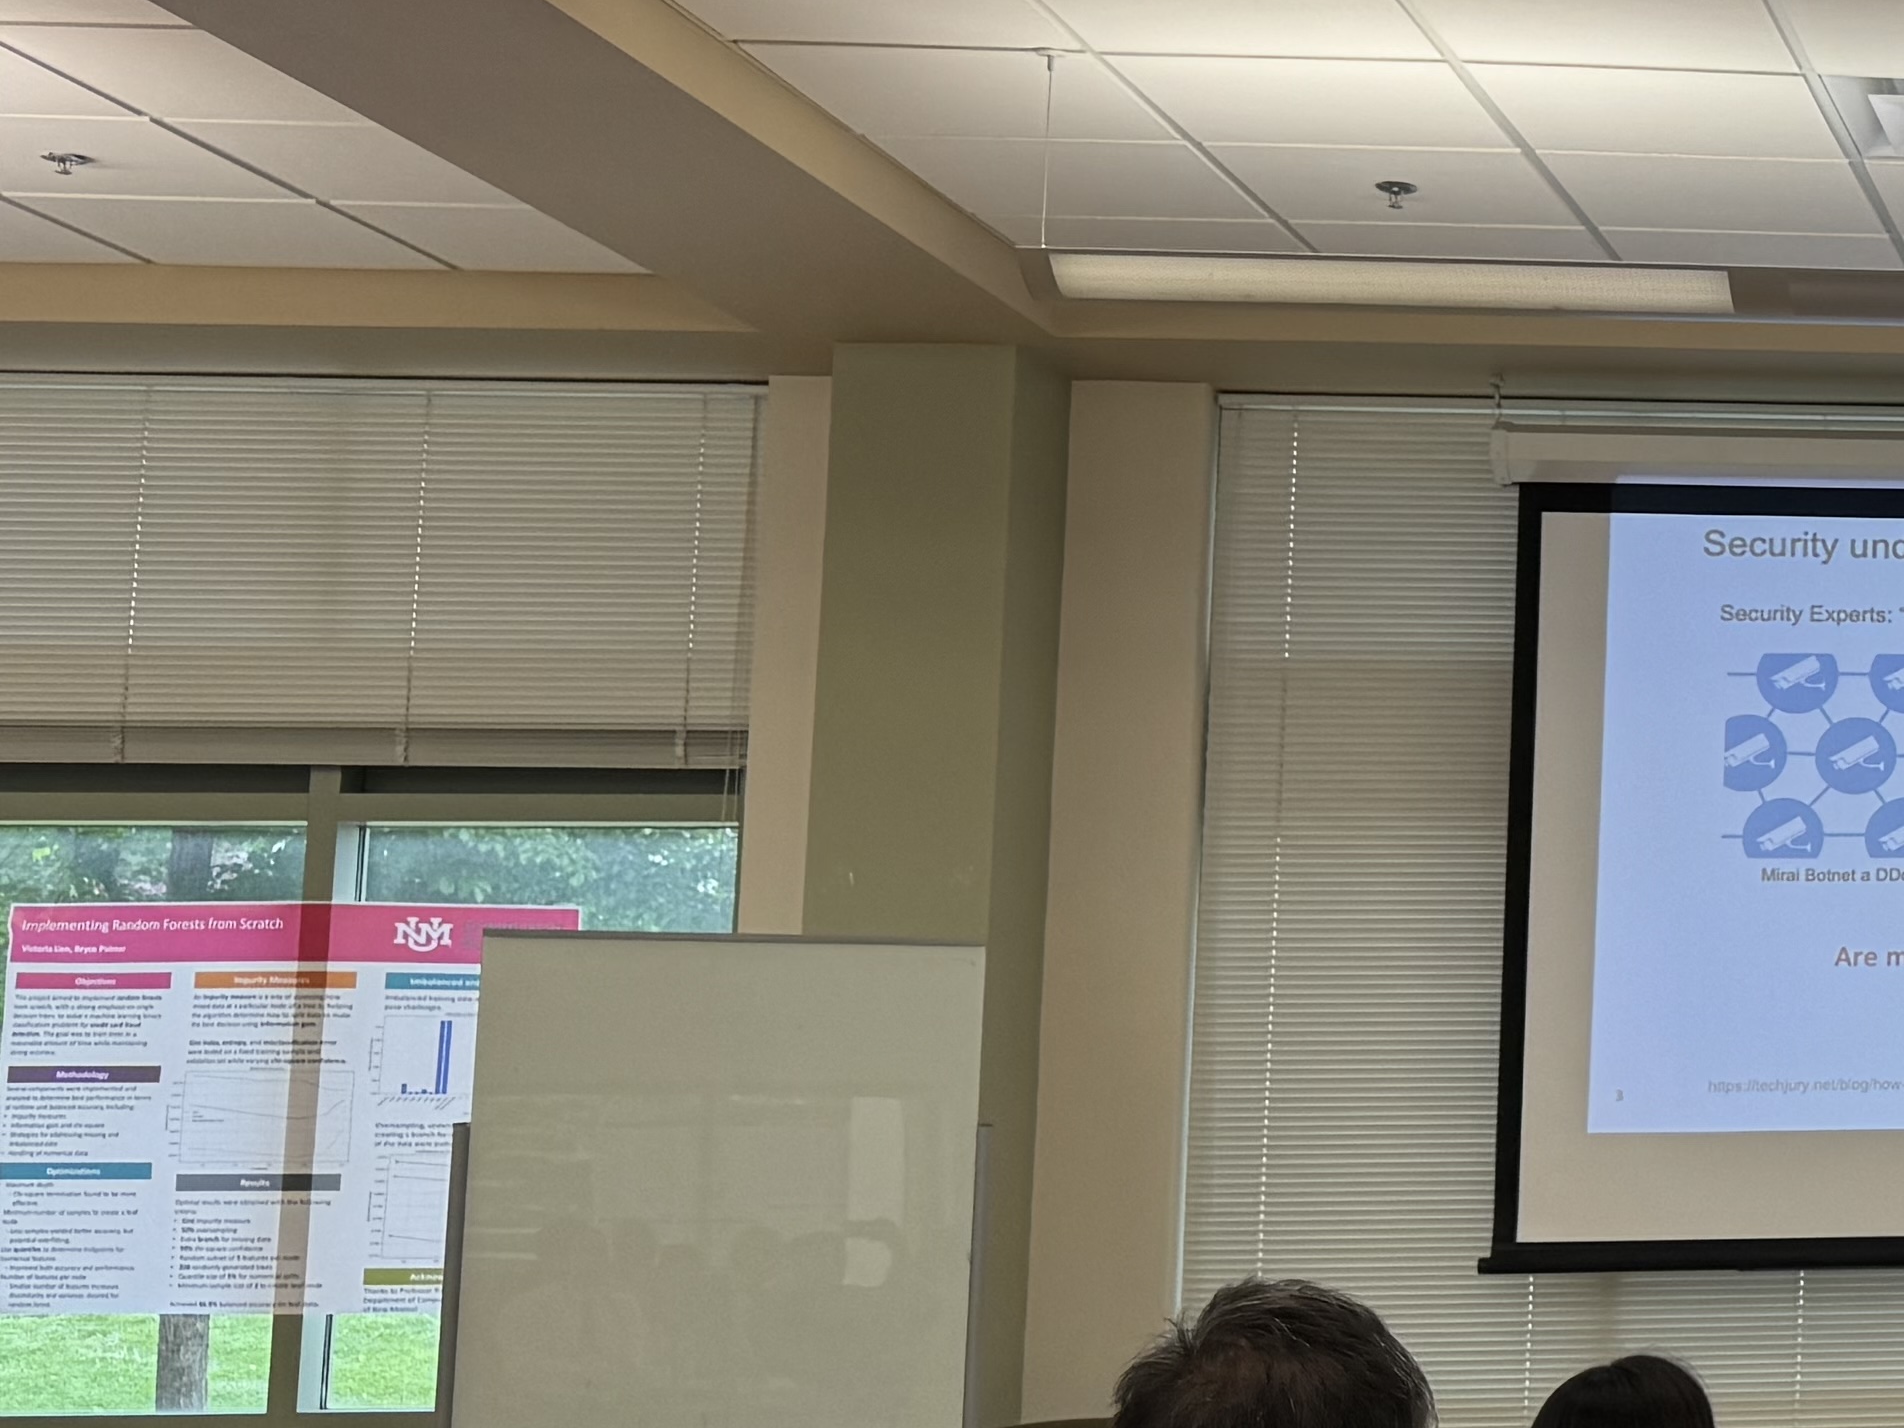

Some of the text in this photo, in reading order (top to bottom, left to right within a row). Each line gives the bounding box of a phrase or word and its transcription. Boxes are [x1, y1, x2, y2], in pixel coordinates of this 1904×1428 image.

[1703, 528, 1840, 566] Security
[1719, 603, 1804, 627] Security
[1809, 604, 1893, 627] Experts:
[1804, 867, 1857, 883] Botnet
[1860, 870, 1871, 882] a
[21, 917, 284, 934] Implementing Random Forests from Scratch
[1833, 946, 1878, 968] Are
[56, 1070, 110, 1081] Methodology
[240, 1178, 270, 1188] Results
